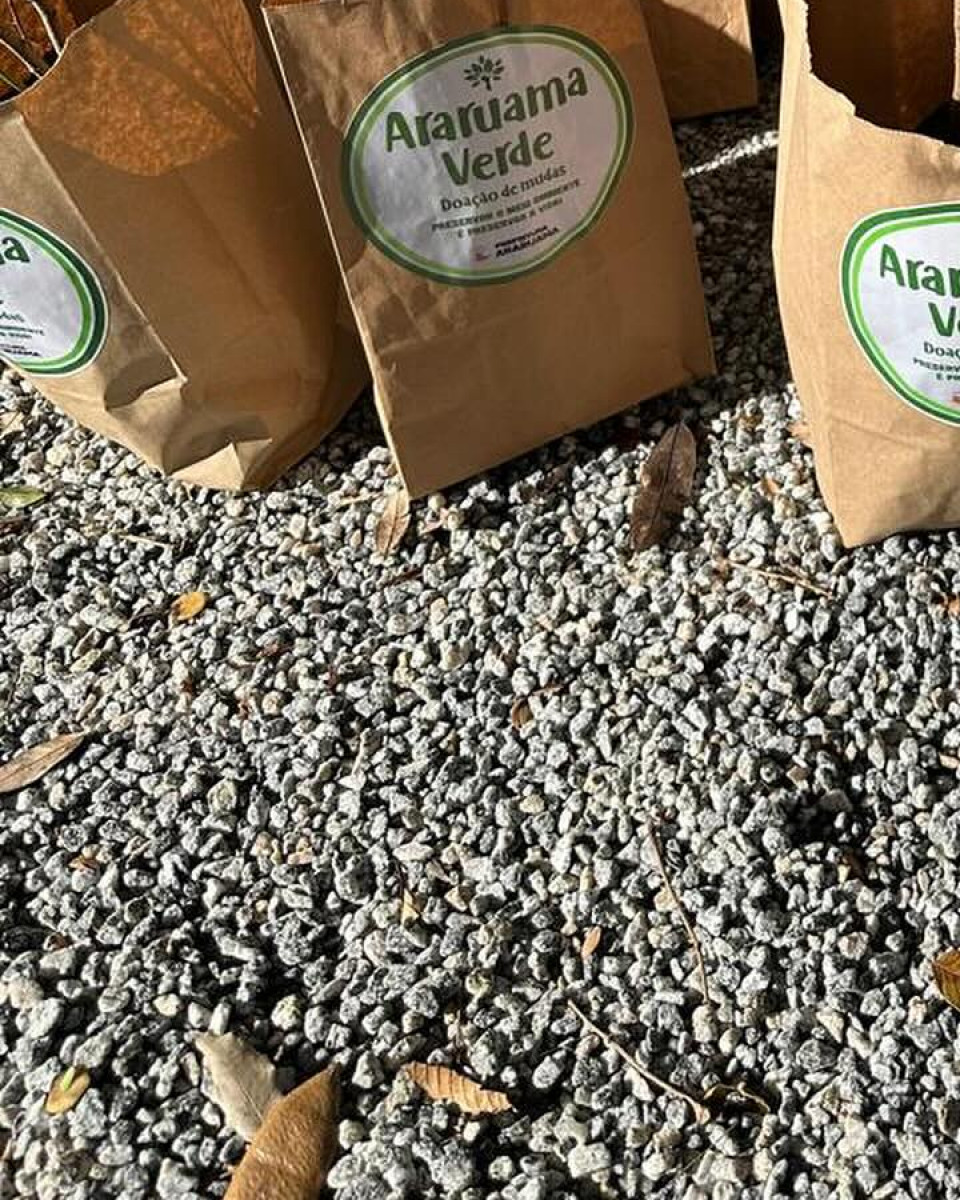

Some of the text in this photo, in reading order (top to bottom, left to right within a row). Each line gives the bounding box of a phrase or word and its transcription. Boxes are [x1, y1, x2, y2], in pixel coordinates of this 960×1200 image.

[383, 66, 588, 153] Araruama
[441, 130, 555, 187] Verde
[440, 165, 568, 212] Doação de mudas
